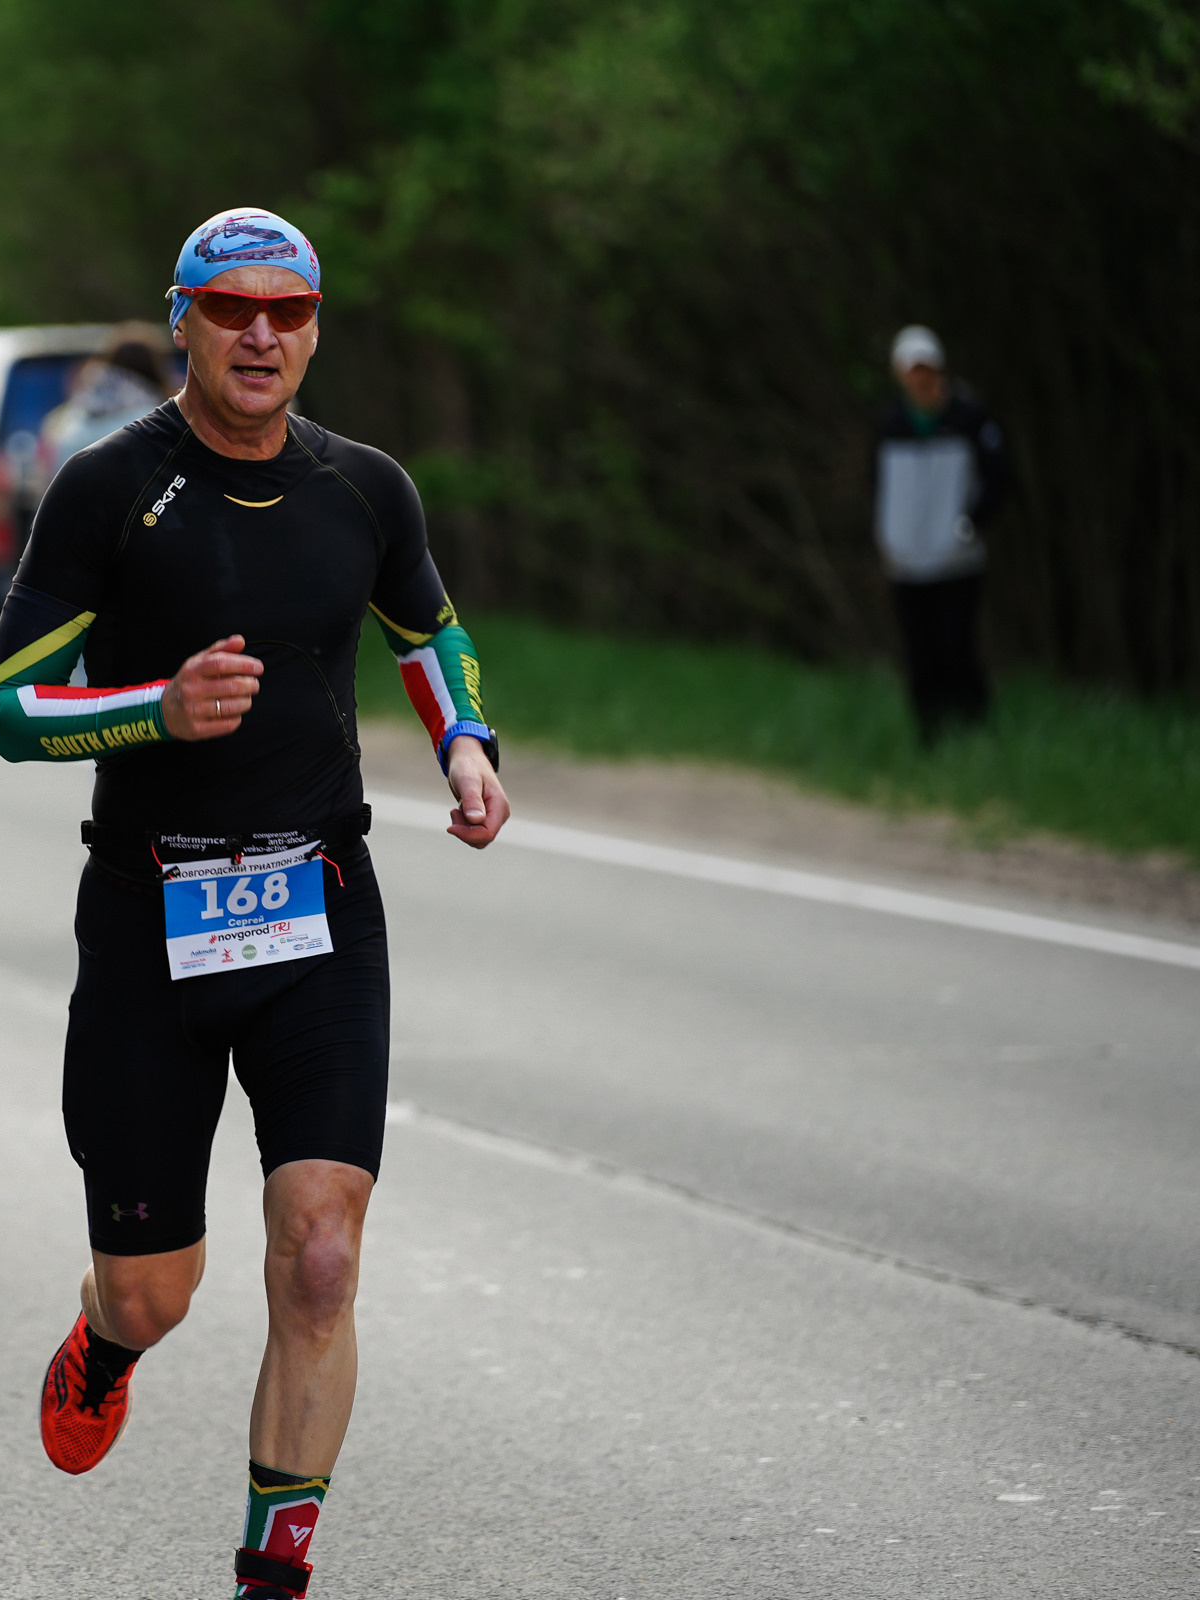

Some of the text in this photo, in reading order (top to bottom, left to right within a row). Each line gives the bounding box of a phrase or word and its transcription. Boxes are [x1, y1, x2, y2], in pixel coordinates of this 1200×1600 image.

[39, 718, 162, 757] SOUTH AFRICA
[160, 833, 227, 845] performance
[267, 834, 308, 846] anti-shock
[169, 842, 207, 852] recovery
[249, 859, 293, 873] ТРИАТЛОН
[200, 872, 290, 920] 168
[227, 915, 265, 928] Сергей
